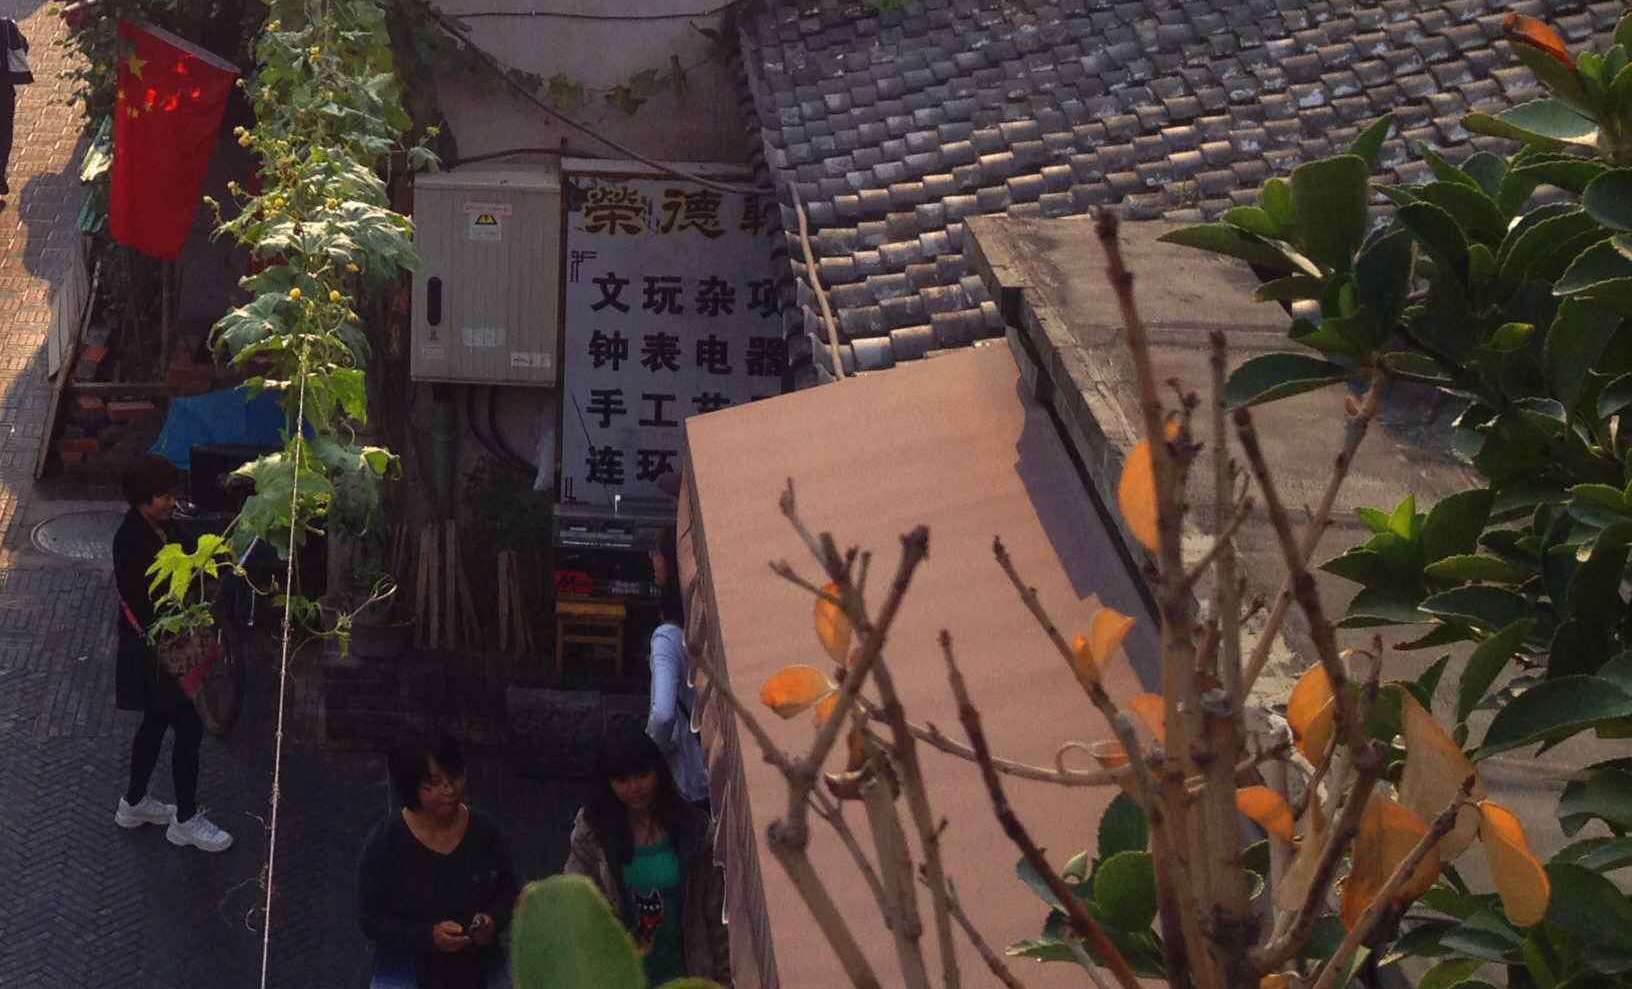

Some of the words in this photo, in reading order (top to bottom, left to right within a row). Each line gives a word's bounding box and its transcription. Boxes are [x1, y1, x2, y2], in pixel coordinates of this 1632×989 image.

[588, 329, 788, 377] 钟表电器
[586, 387, 774, 429] 手工艺
